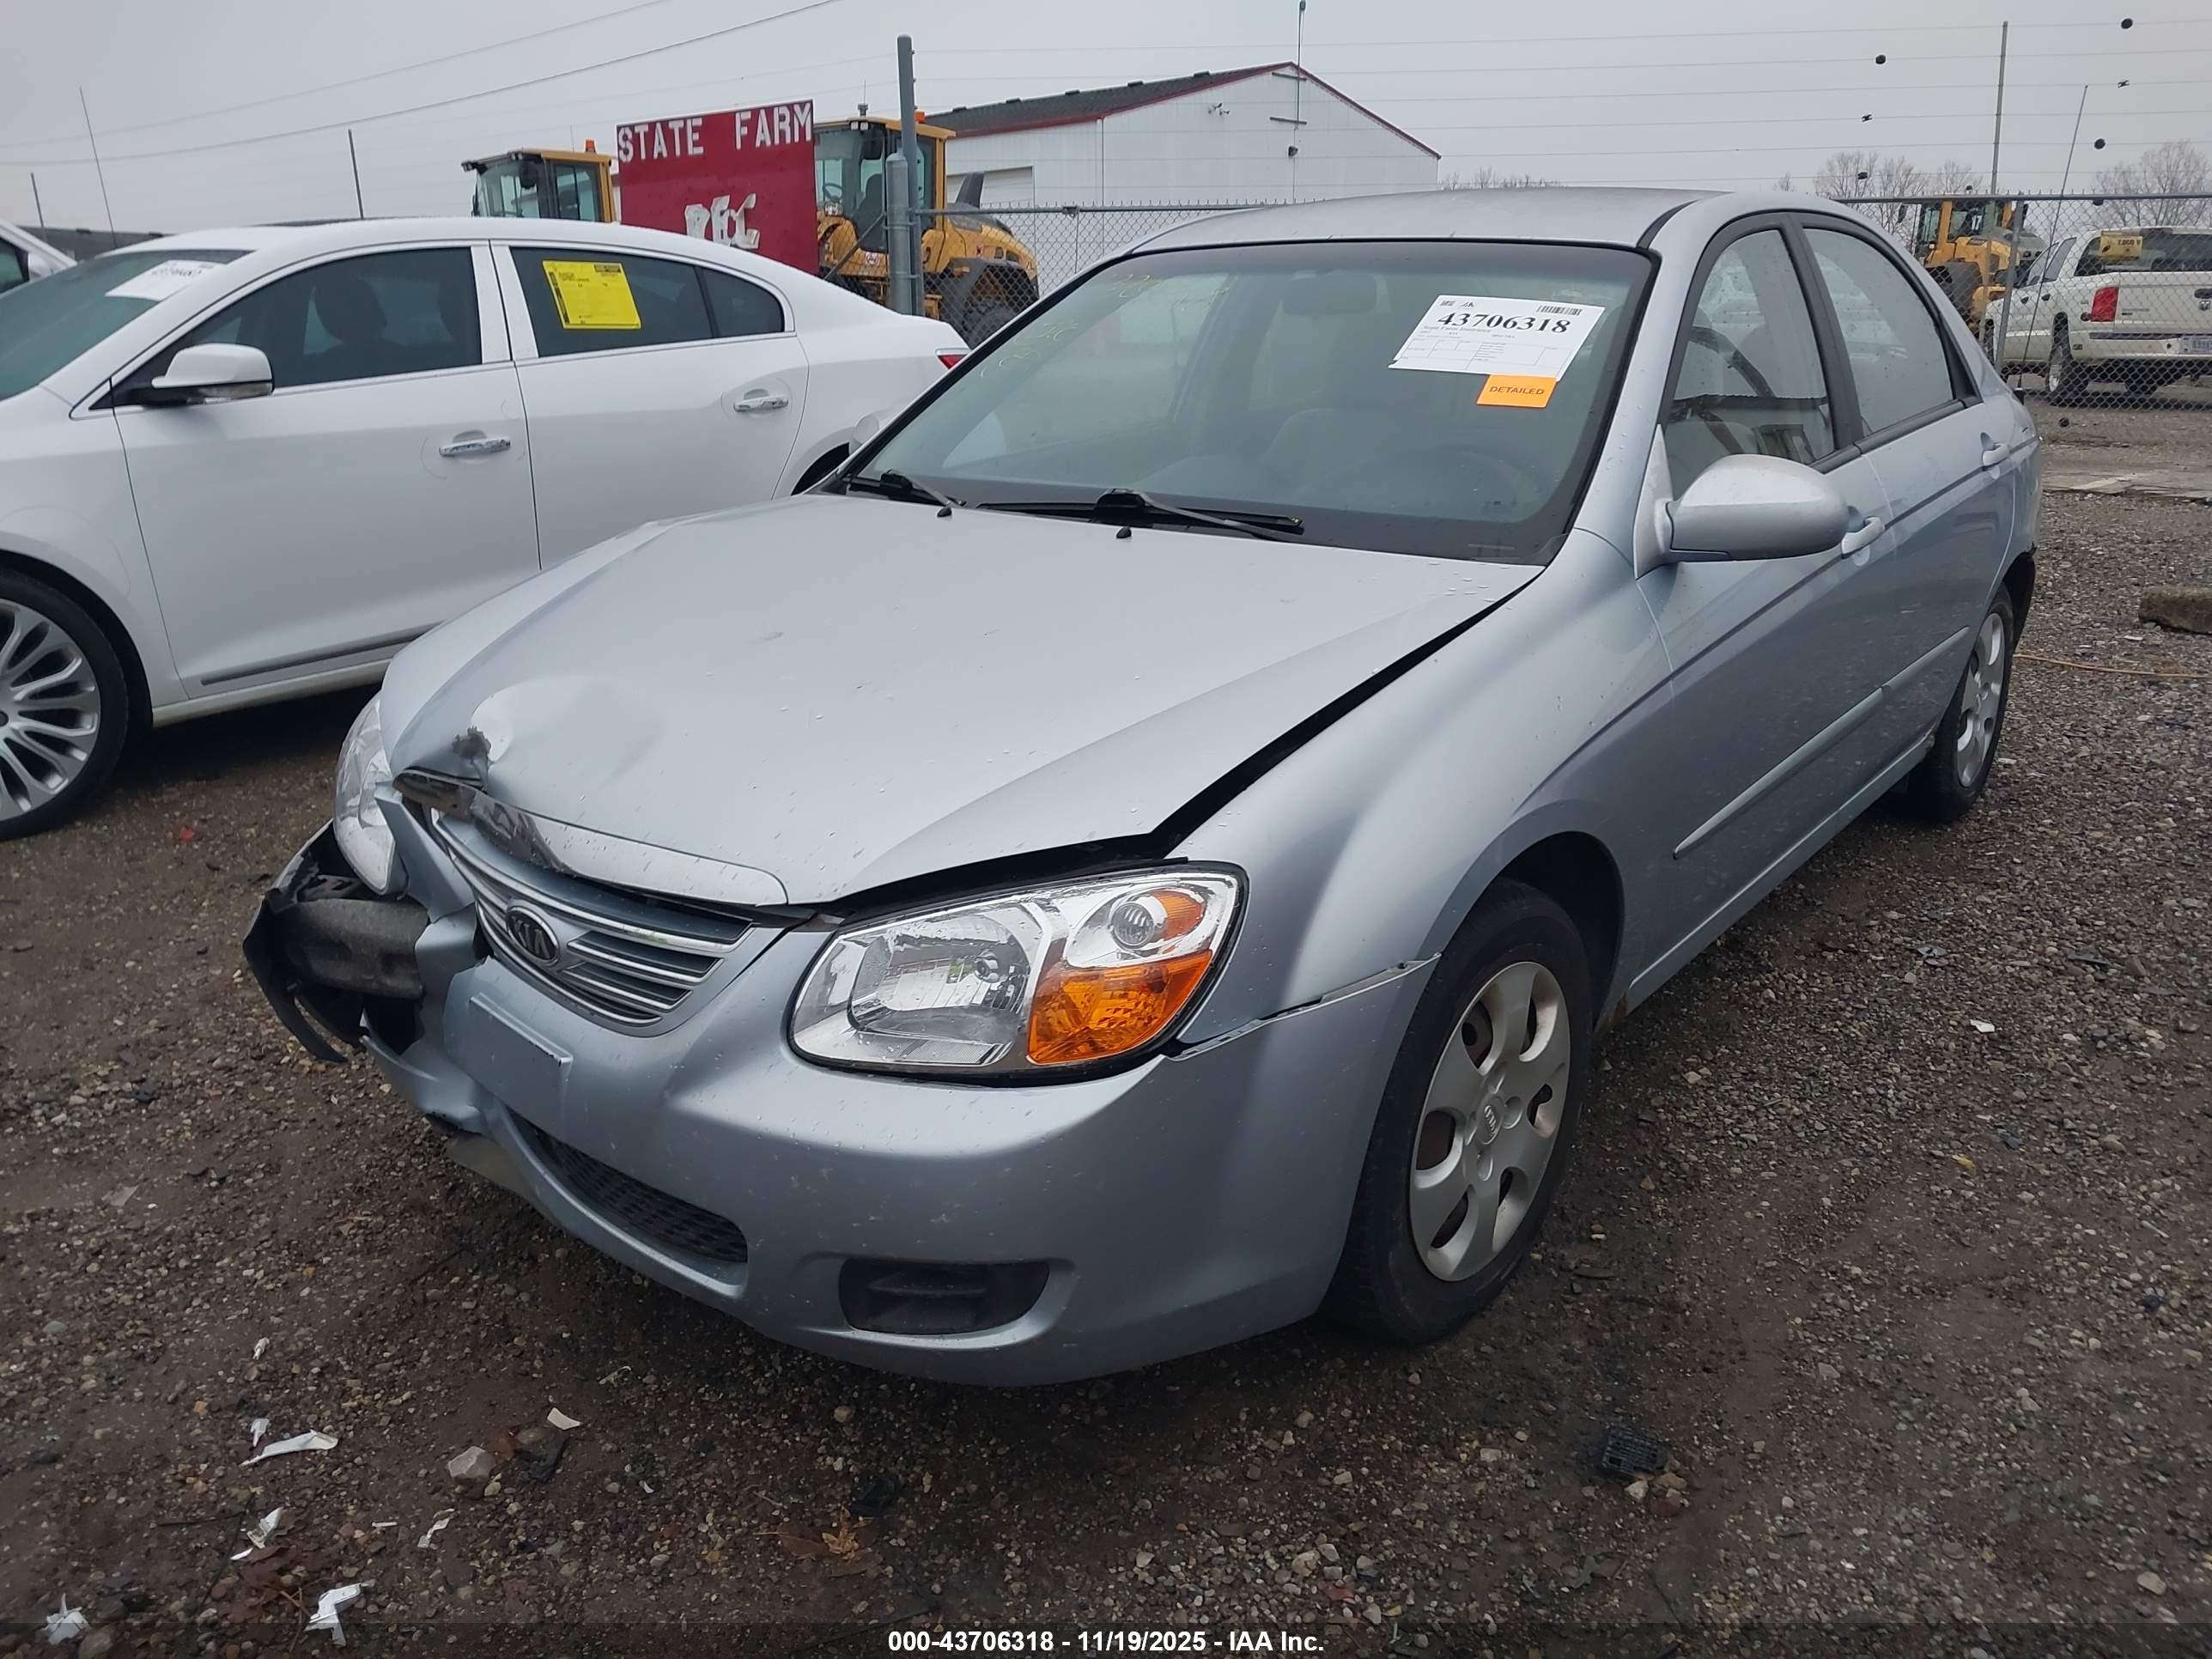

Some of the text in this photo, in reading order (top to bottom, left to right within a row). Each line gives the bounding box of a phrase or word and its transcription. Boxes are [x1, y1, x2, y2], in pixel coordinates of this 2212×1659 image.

[618, 102, 812, 163] STATE FARM
[1437, 312, 1571, 334] 43706318
[1489, 386, 1545, 395] DETAILED
[510, 915, 551, 959] KIA
